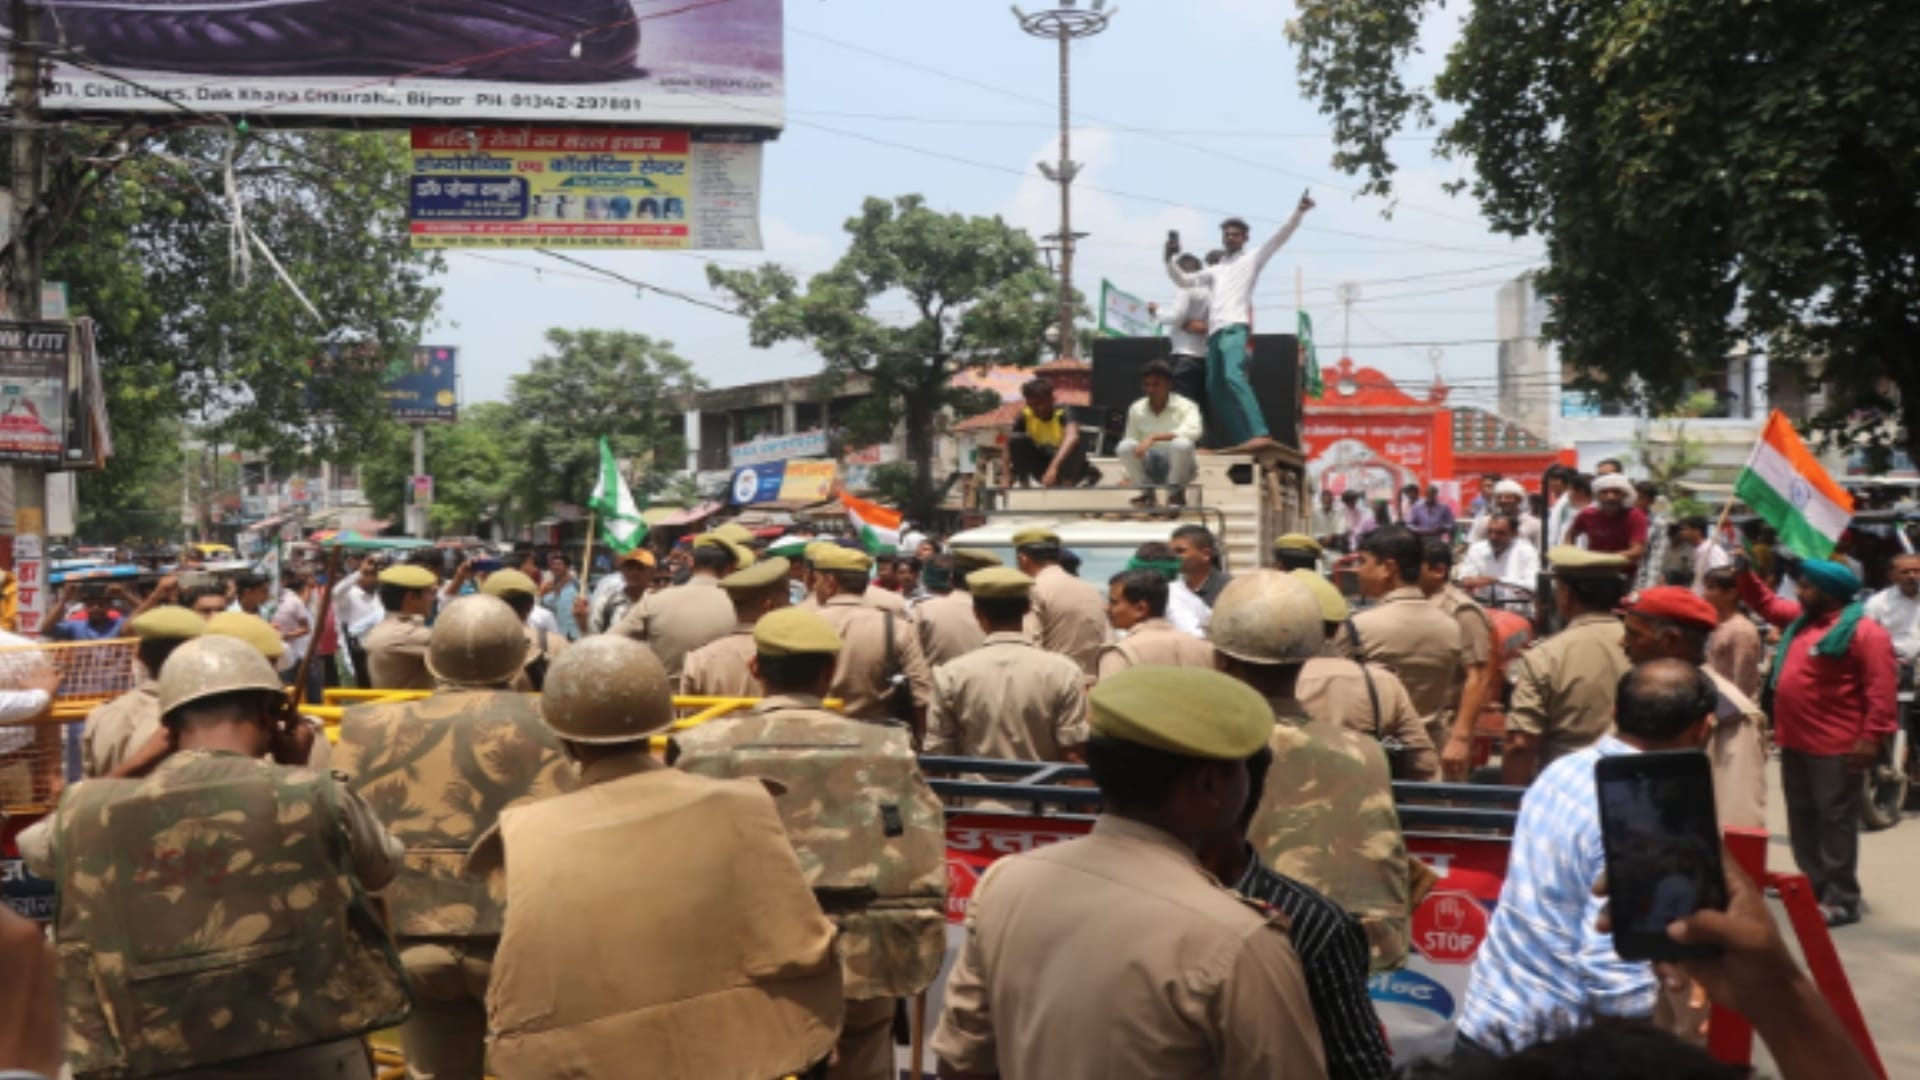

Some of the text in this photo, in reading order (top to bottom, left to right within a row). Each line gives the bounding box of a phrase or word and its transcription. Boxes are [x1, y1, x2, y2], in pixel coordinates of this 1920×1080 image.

[84, 82, 130, 98] Civil
[238, 88, 299, 102] Khana
[407, 91, 464, 108] Bijnor
[1424, 931, 1475, 950] STOP
